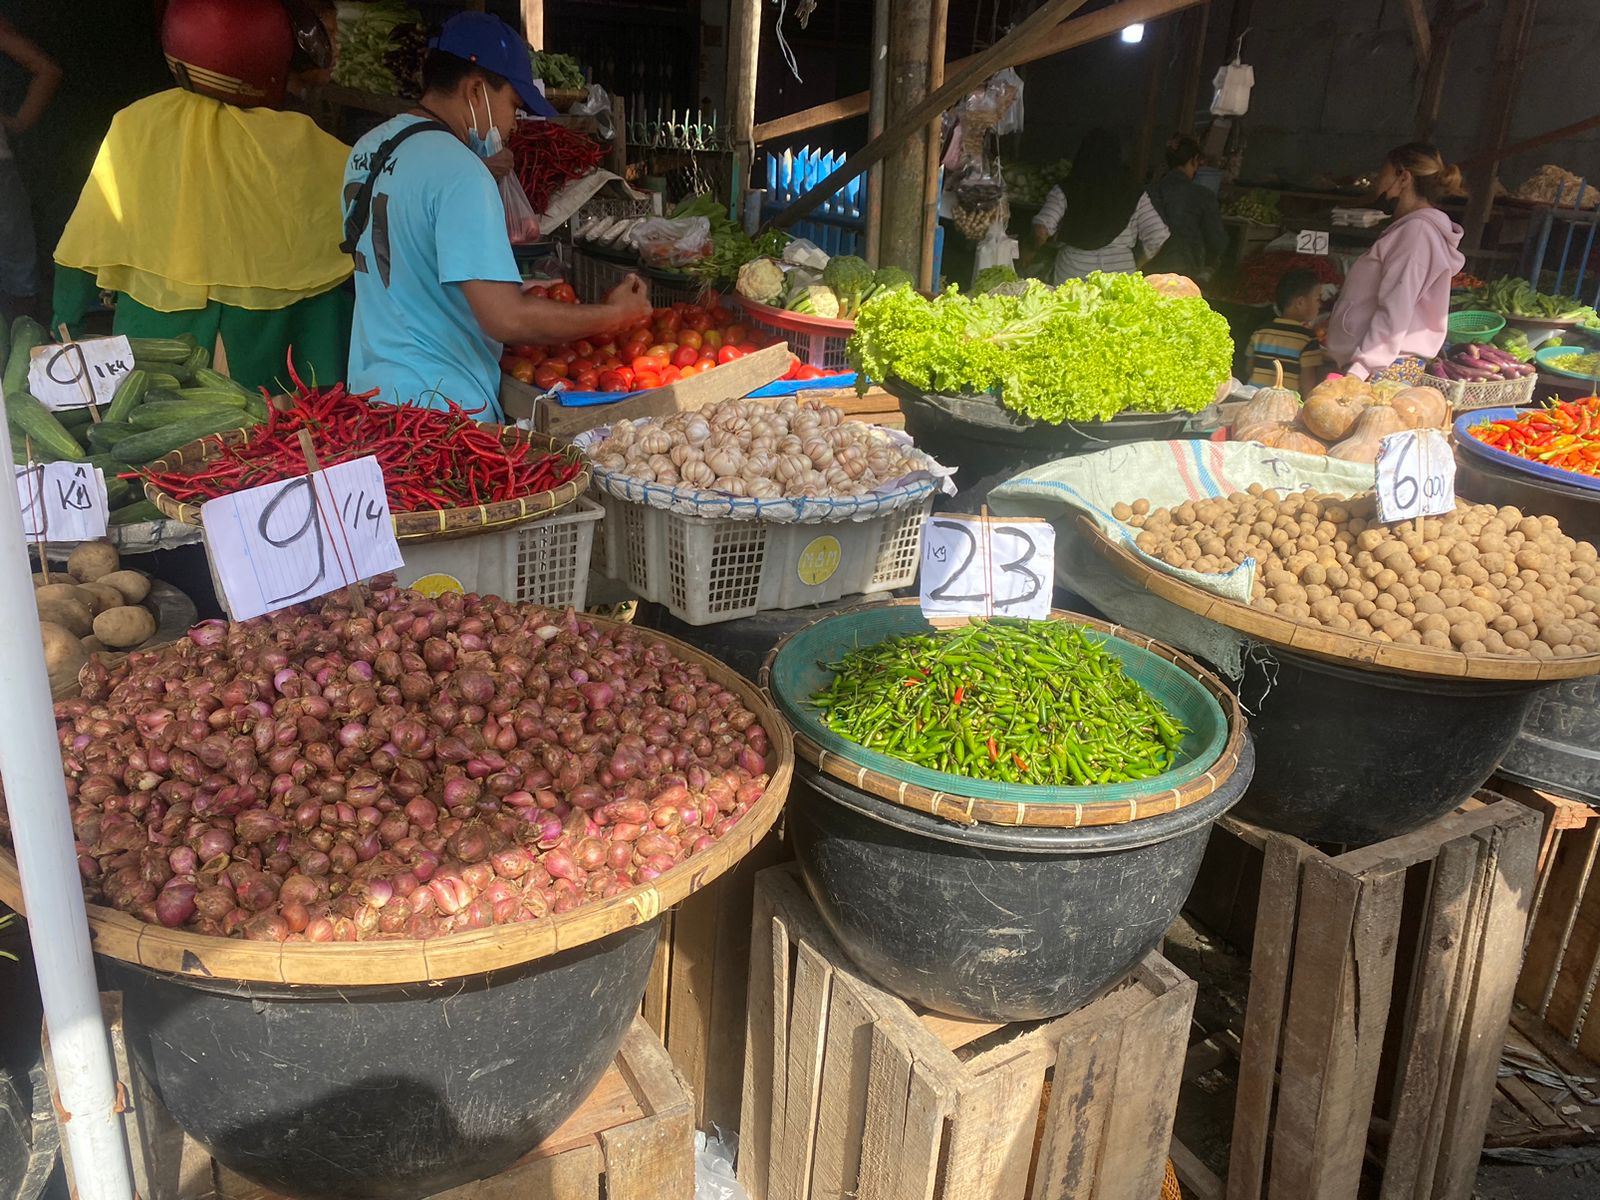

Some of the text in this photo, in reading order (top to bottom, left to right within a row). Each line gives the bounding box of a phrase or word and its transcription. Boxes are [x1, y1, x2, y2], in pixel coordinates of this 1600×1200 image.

[1299, 234, 1328, 251] 20
[46, 344, 96, 406] 9
[1393, 434, 1418, 509] 6
[258, 475, 325, 604] 9
[926, 521, 1041, 608] 23
